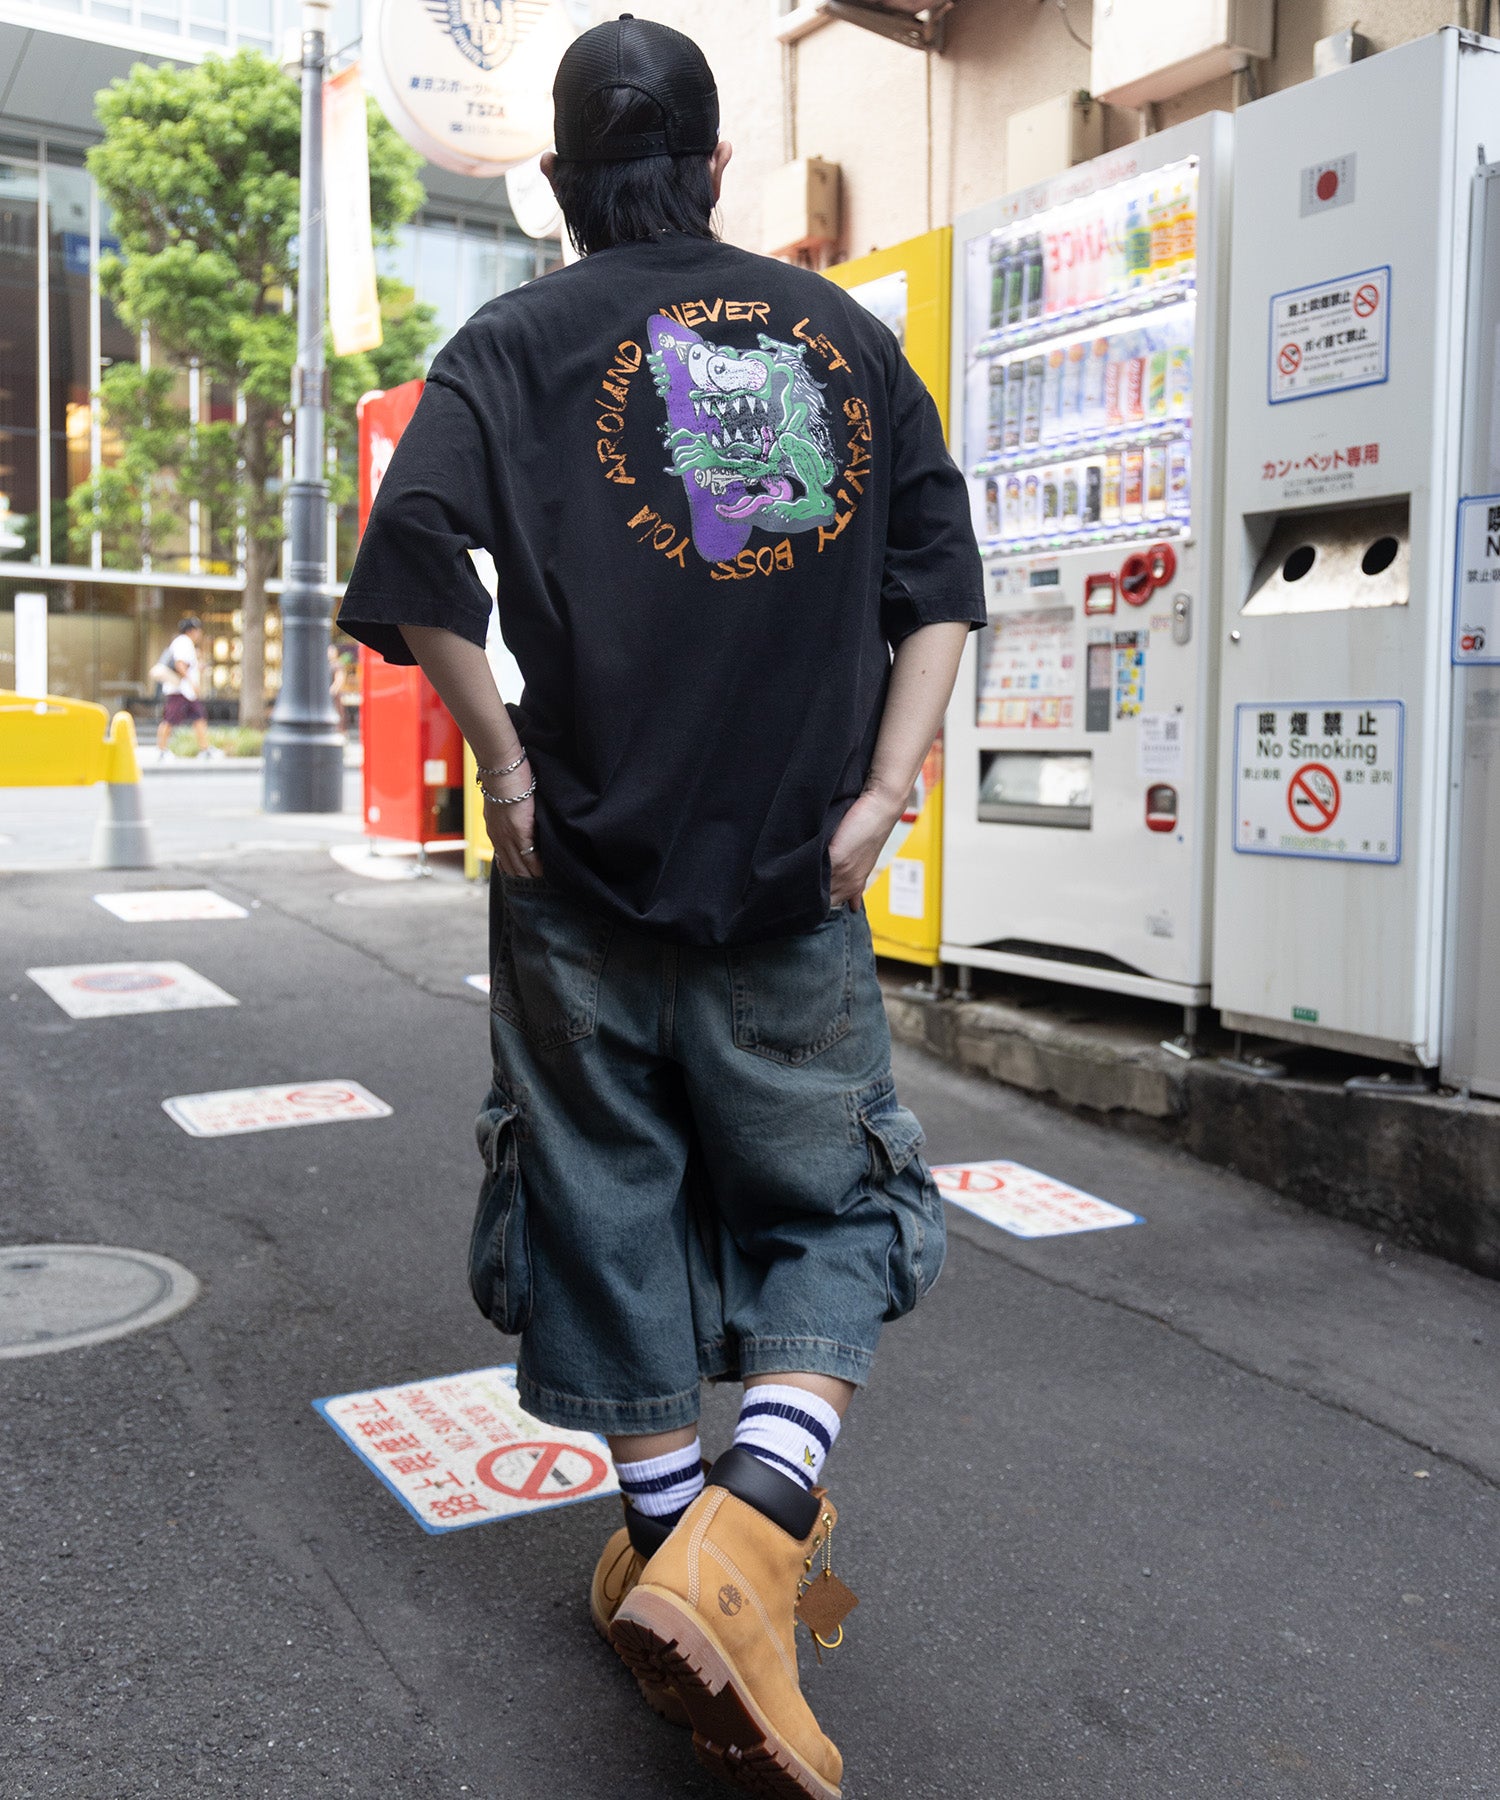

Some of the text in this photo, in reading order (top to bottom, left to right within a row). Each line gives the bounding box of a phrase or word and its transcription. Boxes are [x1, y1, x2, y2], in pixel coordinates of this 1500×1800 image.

[595, 298, 872, 581] NEVER LET GRAVITY BOSS YOU AROUND
[1258, 711, 1377, 736] 喫煙禁止
[1257, 737, 1377, 765] No Smoking
